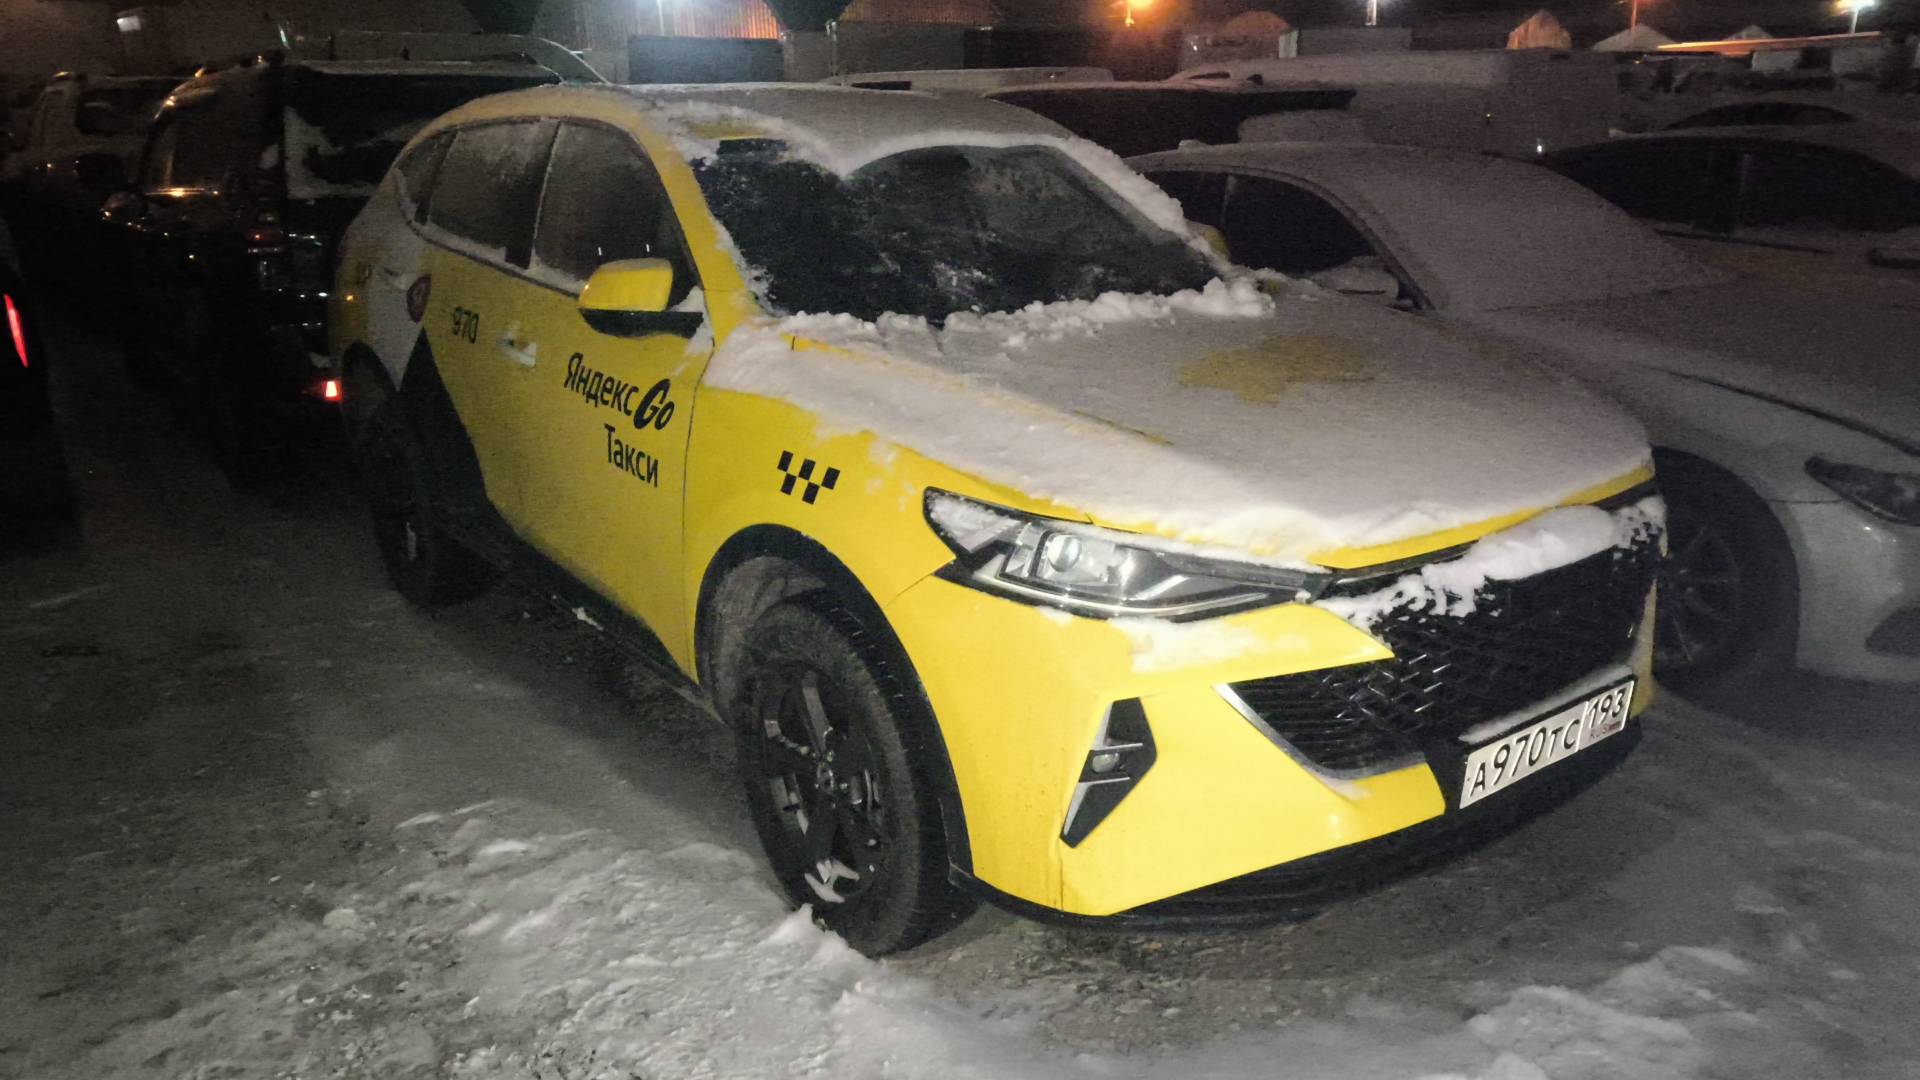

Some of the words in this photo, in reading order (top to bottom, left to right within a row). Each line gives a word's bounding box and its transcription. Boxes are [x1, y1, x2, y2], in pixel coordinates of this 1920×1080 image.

[452, 306, 479, 344] 970
[564, 352, 639, 417] Яндекс
[633, 378, 675, 430] Go
[604, 424, 659, 487] Такси
[1586, 690, 1626, 729] 193
